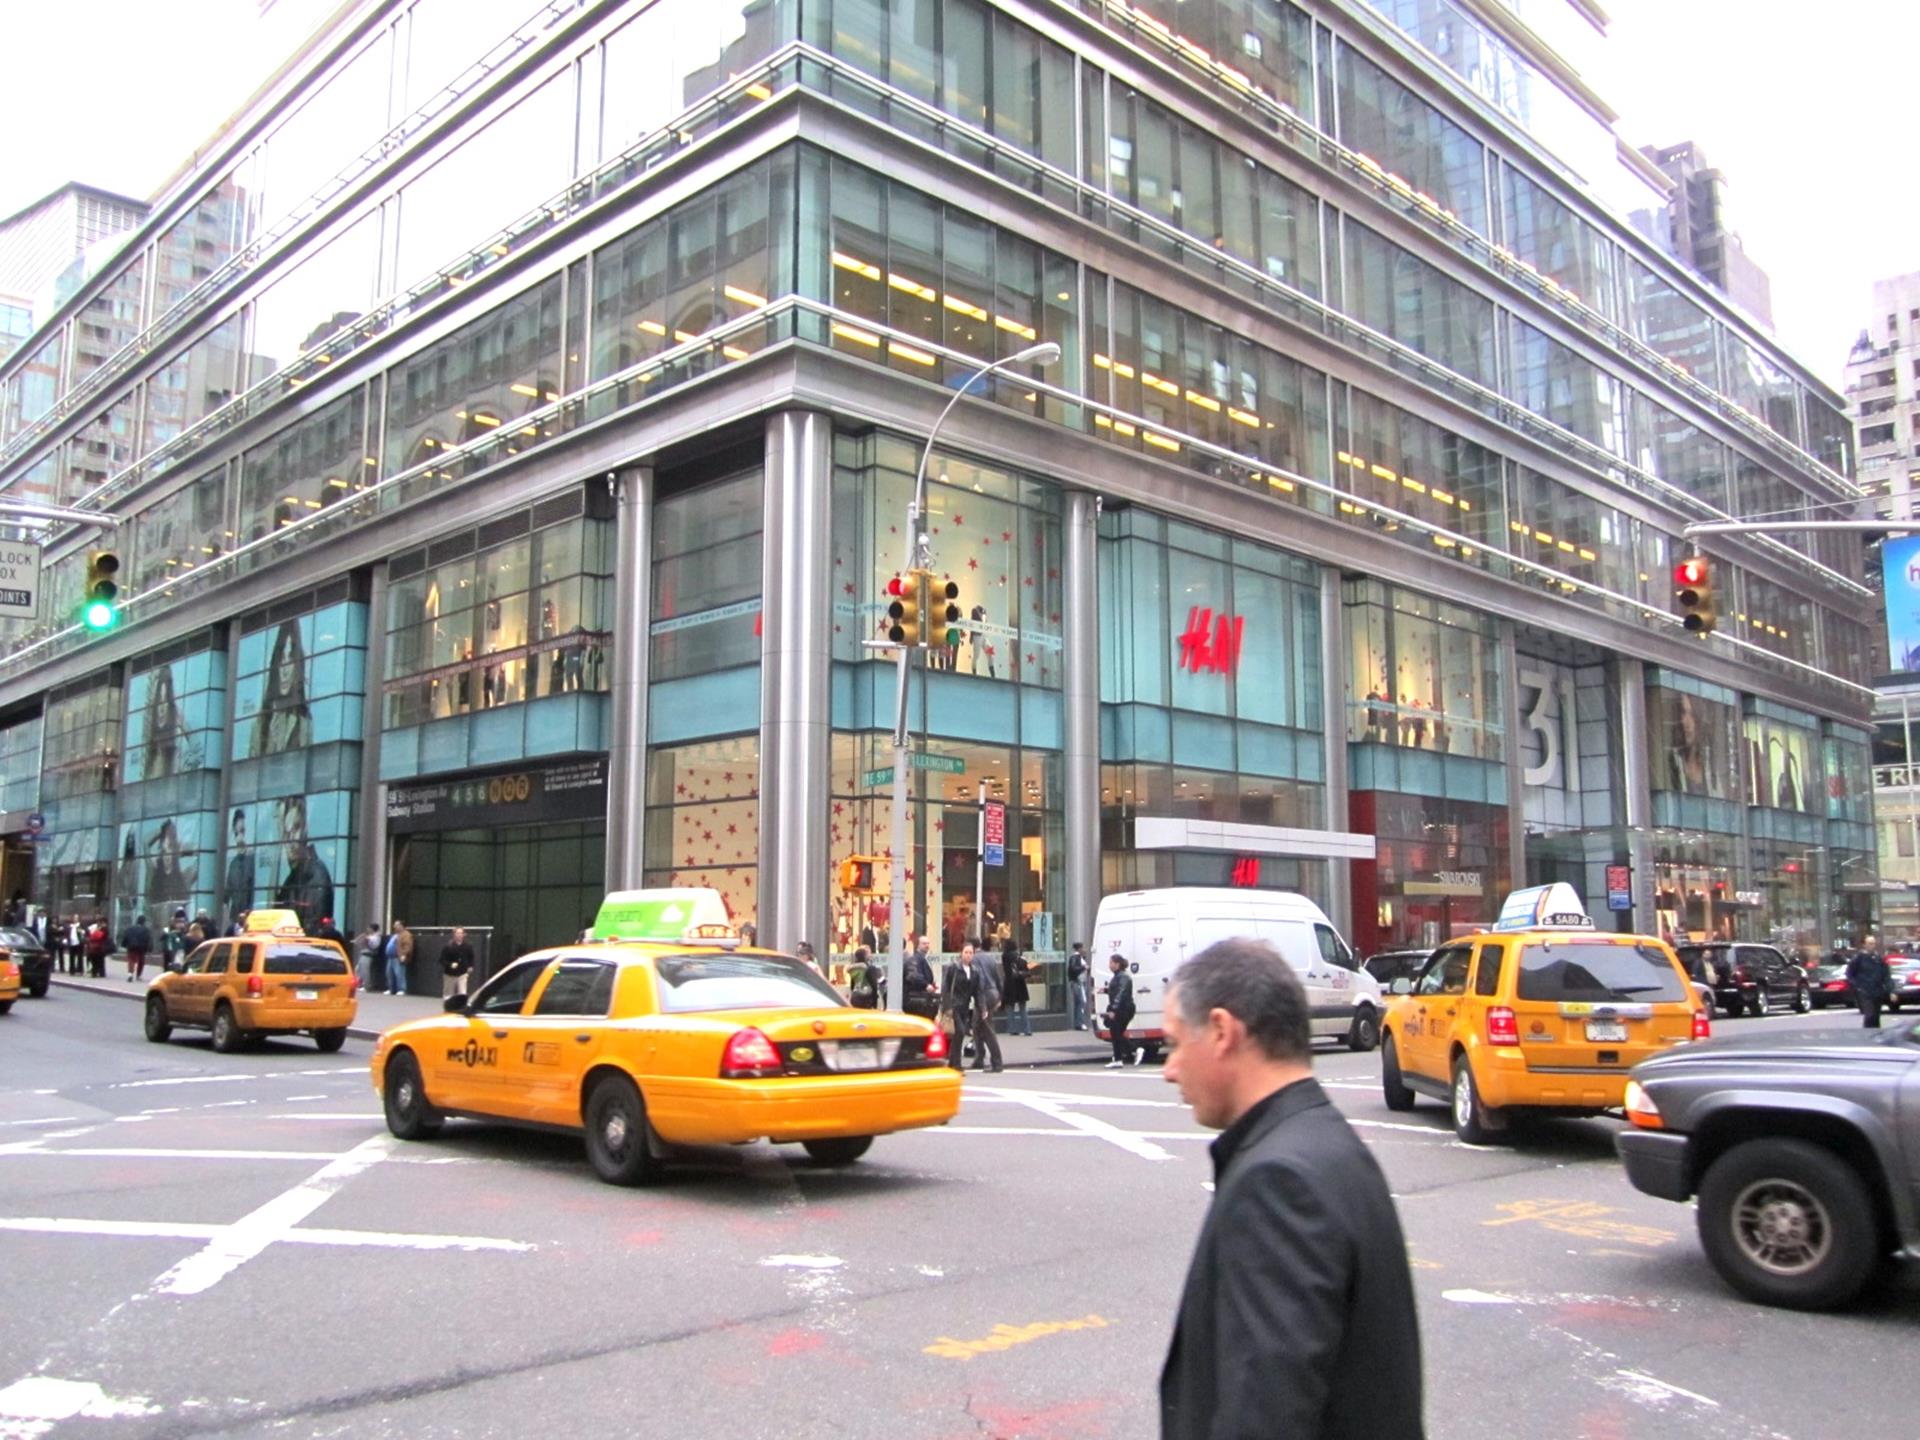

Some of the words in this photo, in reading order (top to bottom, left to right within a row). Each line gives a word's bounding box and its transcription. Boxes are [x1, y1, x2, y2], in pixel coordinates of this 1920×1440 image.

[1177, 605, 1245, 675] H&M
[1519, 669, 1580, 793] 31
[916, 755, 954, 771] LEXINGTON
[452, 788, 460, 803] 4
[465, 787, 473, 802] 5
[478, 784, 486, 800] 6
[1231, 857, 1261, 888] H&M
[1439, 871, 1480, 888] SWAROVSKI
